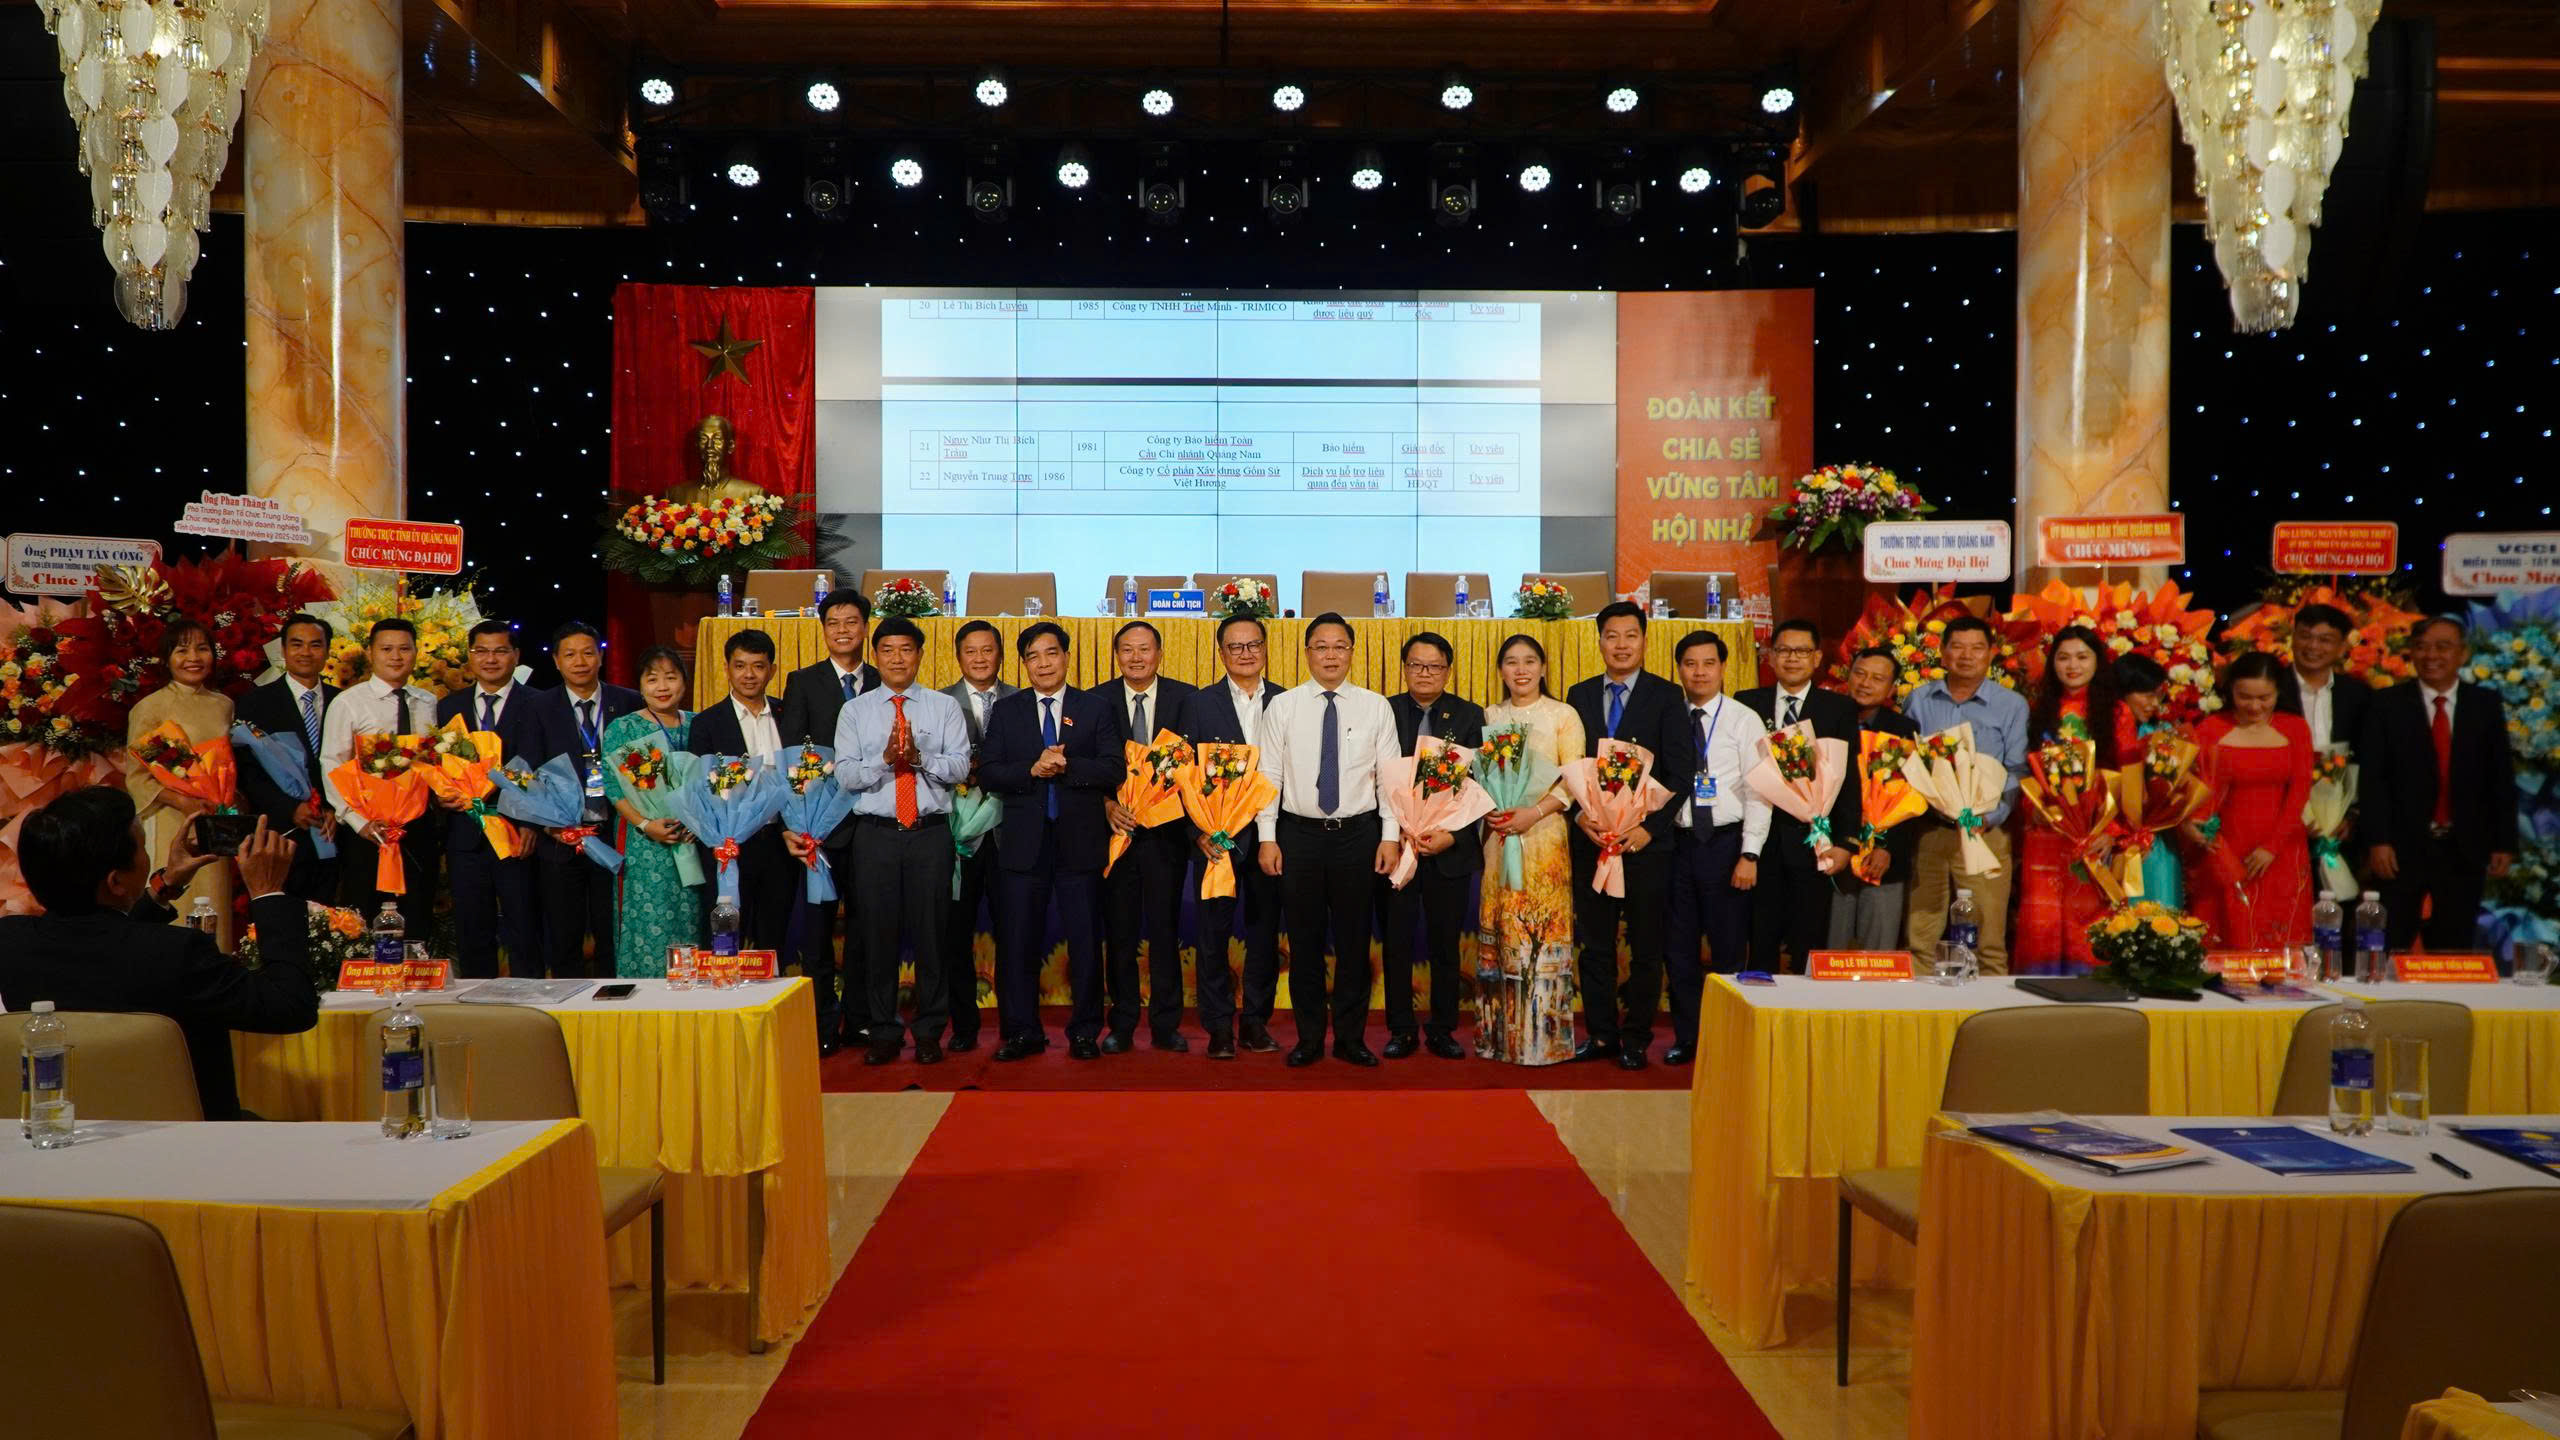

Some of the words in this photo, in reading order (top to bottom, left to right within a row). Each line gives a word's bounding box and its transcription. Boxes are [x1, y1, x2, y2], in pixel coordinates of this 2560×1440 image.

[919, 301, 930, 310] 20
[1078, 302, 1099, 311] 1985
[1112, 302, 1136, 313] Công
[1138, 303, 1148, 313] ty
[1151, 302, 1181, 311] TNHH
[1207, 302, 1232, 311] Minh
[1242, 303, 1287, 312] TRIMICO
[1646, 390, 1722, 421] ĐOÀN
[1727, 385, 1777, 420] KẾT
[919, 442, 930, 451] 21
[1147, 435, 1171, 446] Công
[1173, 437, 1182, 447] ty
[1662, 436, 1724, 461] CHIA
[1729, 427, 1761, 461] SẺ
[1077, 443, 1097, 452] 1981
[1158, 450, 1175, 459] Chi
[1239, 450, 1261, 459] Nam
[919, 472, 930, 481] 22
[981, 471, 1008, 483] Trung
[1044, 472, 1065, 481] 1986
[1119, 465, 1143, 476] Công
[1146, 467, 1155, 477] ty
[1646, 471, 1721, 500] VỮNG
[1725, 469, 1779, 499] TÂM
[1651, 512, 1698, 548] HỘI
[1703, 512, 1754, 548] NHẬ
[444, 534, 459, 545] NAM
[1980, 535, 1995, 548] NAM
[50, 547, 84, 562] PHẠM
[2064, 540, 2104, 559] CHÚC
[2498, 544, 2557, 554] VCCI
[351, 545, 380, 561] CHÚC
[382, 546, 413, 562] MỪNG
[414, 551, 432, 566] ĐẠI
[433, 551, 453, 567] HỘI
[2284, 551, 2312, 566] CHÚC
[2366, 553, 2385, 568] HỘI
[1947, 555, 1966, 572] Đại
[1970, 555, 1989, 572] Hội
[1152, 598, 1171, 609] ĐOÀN
[1172, 598, 1185, 609] CHỦ
[1186, 600, 1202, 610] TỊCH
[346, 964, 361, 977] Ông
[415, 967, 442, 977] QUANG
